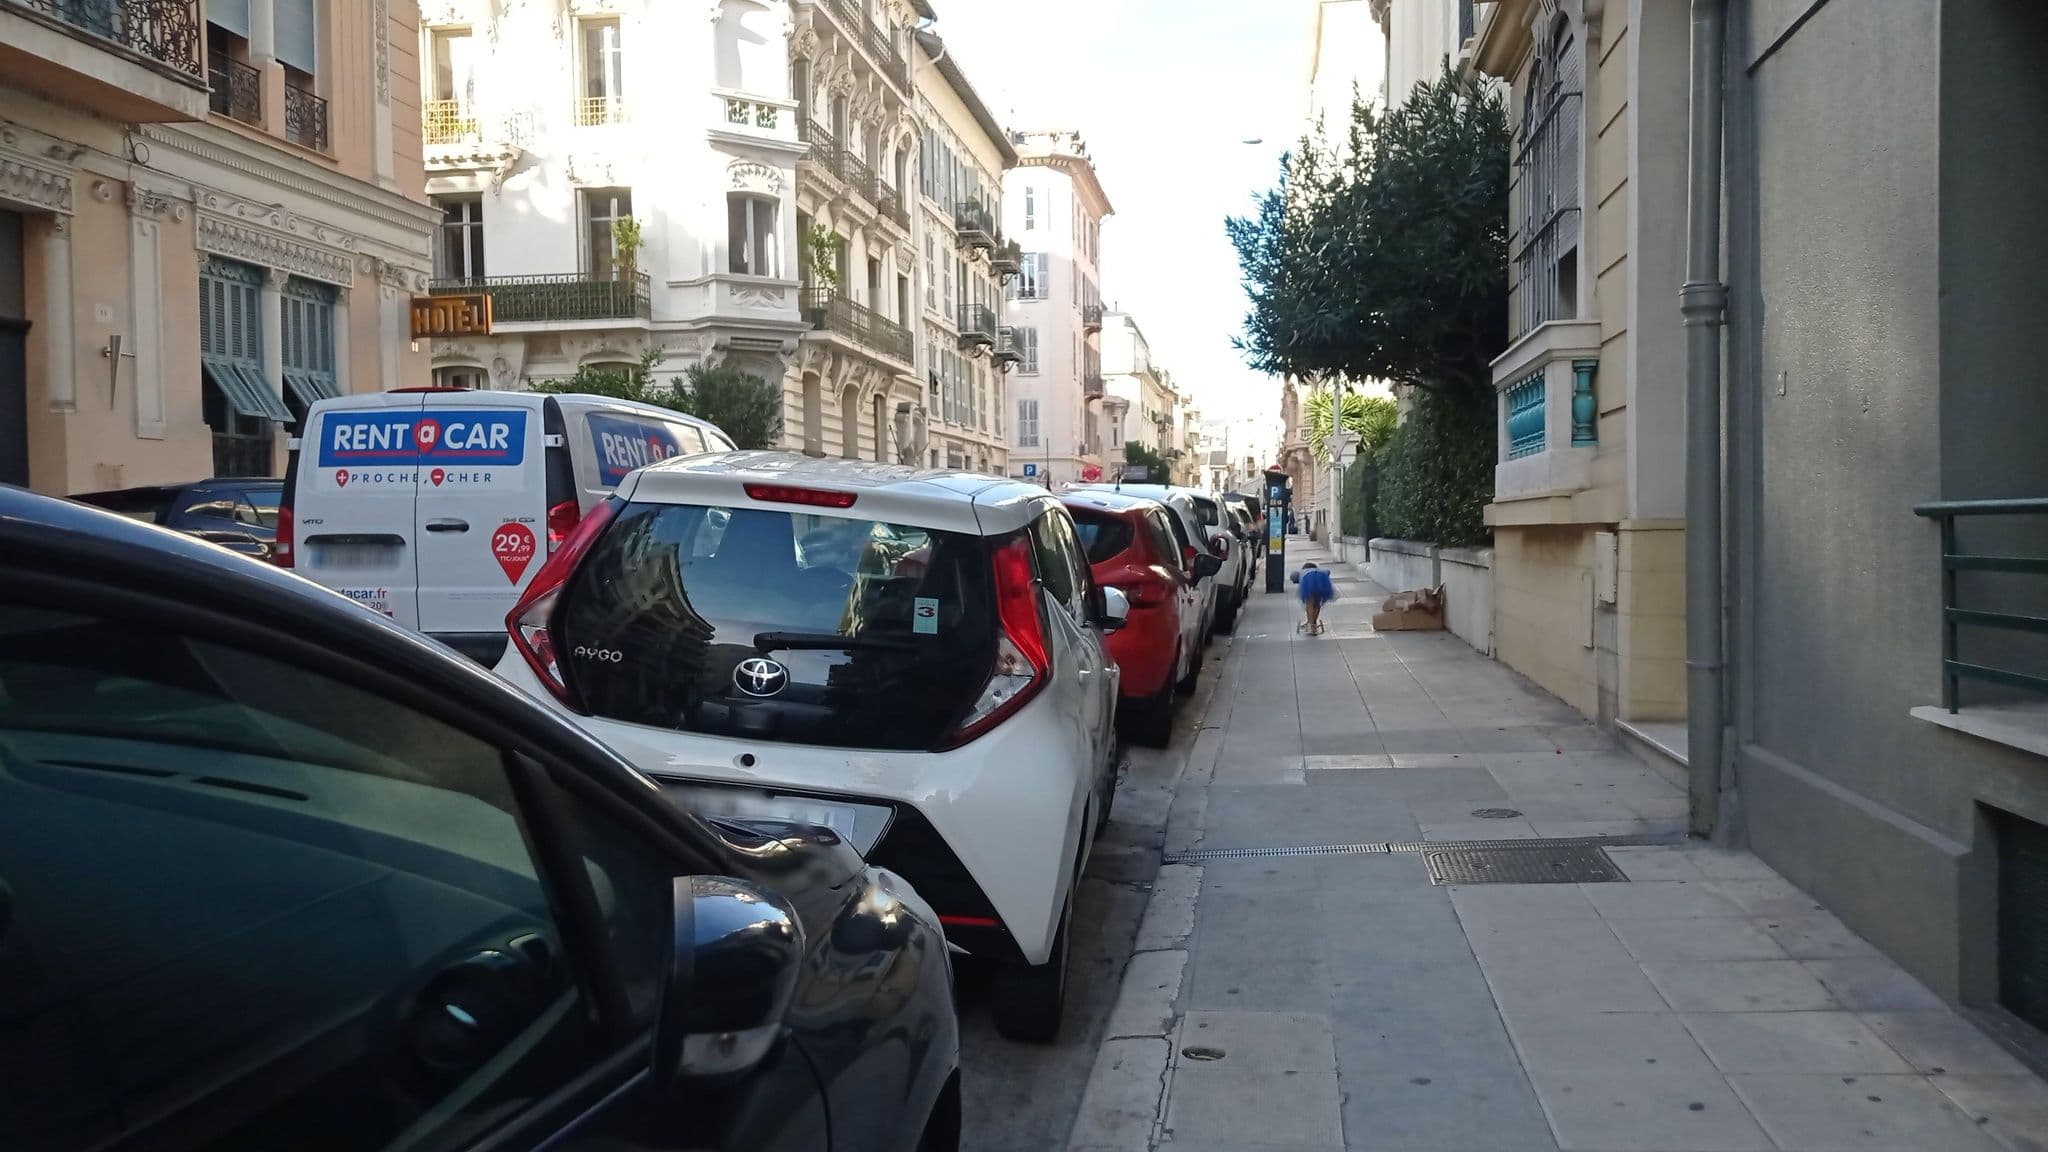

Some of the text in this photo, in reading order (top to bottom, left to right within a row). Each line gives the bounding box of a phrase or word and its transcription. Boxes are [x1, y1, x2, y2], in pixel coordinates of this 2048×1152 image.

[414, 301, 484, 334] HOTEL
[333, 423, 510, 450] RENT a CAR
[601, 432, 648, 468] RENT
[446, 473, 492, 483] CHER
[1271, 486, 1279, 498] P
[917, 606, 935, 618] 3
[574, 646, 623, 663] AYGO
